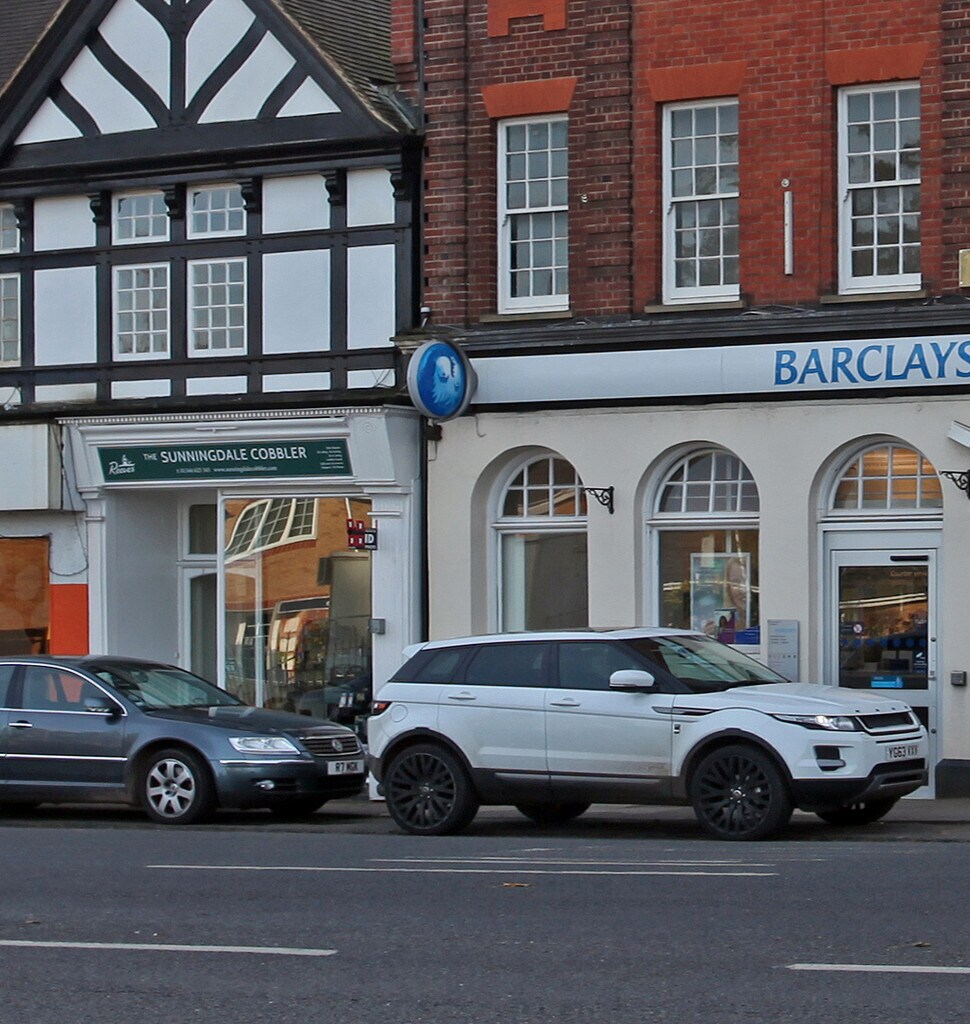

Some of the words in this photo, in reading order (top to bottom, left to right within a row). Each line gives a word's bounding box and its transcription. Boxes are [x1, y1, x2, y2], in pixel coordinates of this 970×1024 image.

[143, 453, 158, 461] THE
[160, 448, 249, 464] SUNNINGDALE
[250, 446, 307, 460] COBBLER
[336, 762, 344, 772] R7
